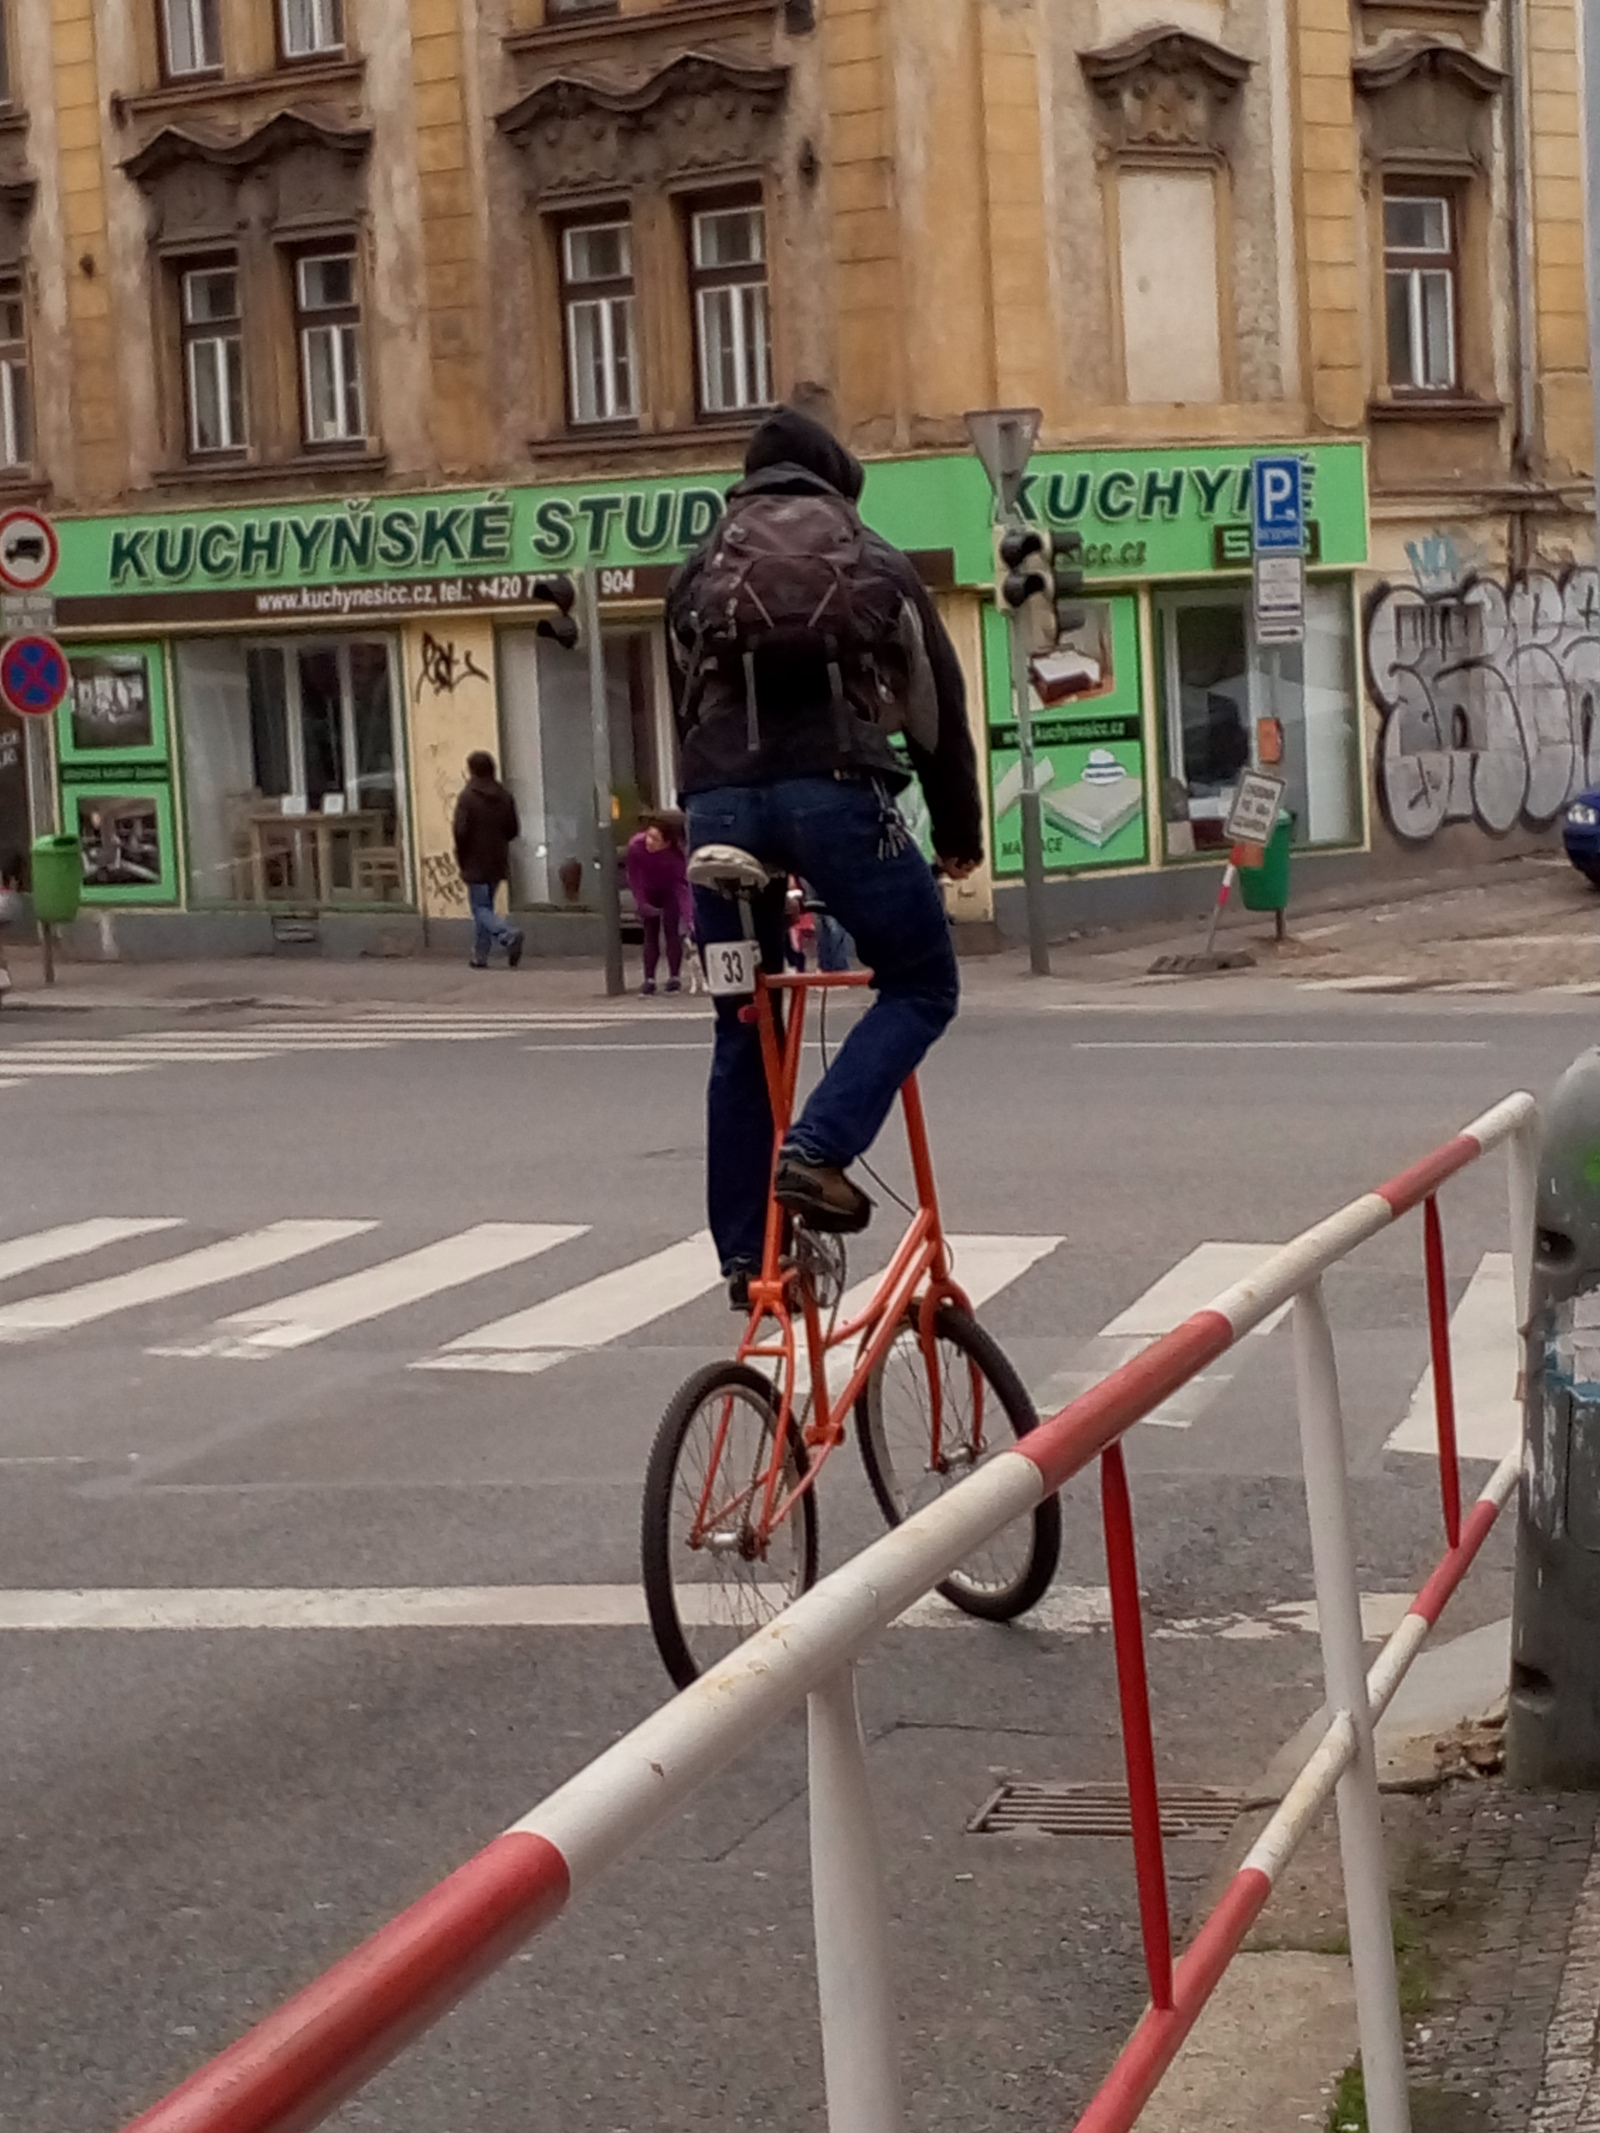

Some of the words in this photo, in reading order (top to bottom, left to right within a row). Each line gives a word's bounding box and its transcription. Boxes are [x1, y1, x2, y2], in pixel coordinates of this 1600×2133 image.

[1263, 467, 1292, 522] P
[109, 490, 513, 583] KUCHYŇSKÉ
[477, 575, 521, 600] +420
[602, 569, 635, 595] 904
[721, 950, 744, 984] 33
